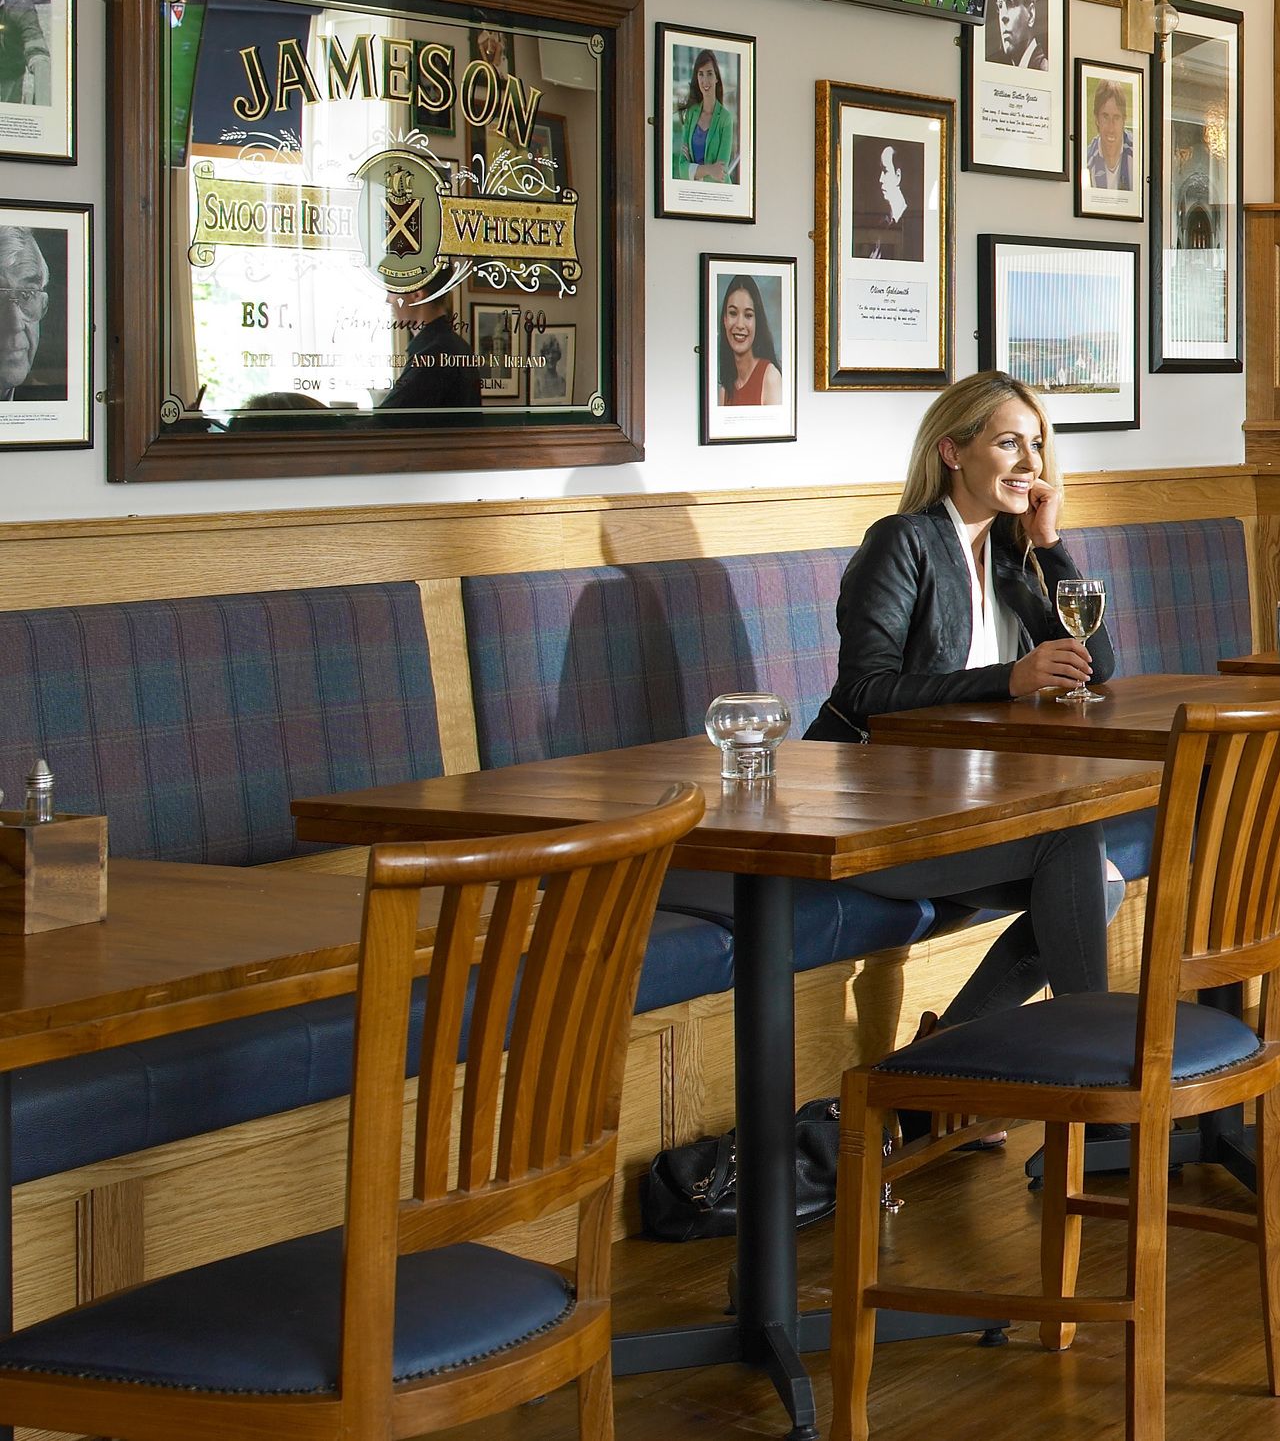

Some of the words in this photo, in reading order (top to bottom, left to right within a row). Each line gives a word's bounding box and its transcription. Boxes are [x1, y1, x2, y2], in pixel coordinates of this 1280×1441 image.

[233, 33, 544, 147] JAMESON
[204, 192, 294, 233] SMOOTH
[301, 200, 352, 236] IRISH
[450, 208, 566, 248] WHISKEY
[241, 302, 292, 328] EST.
[502, 310, 547, 334] 1780
[241, 350, 276, 368] TRIPL
[411, 353, 434, 368] AND
[440, 353, 485, 368] BOTTLED
[489, 354, 500, 368] IN
[504, 354, 546, 368] IRELAND
[294, 378, 321, 390] BOW
